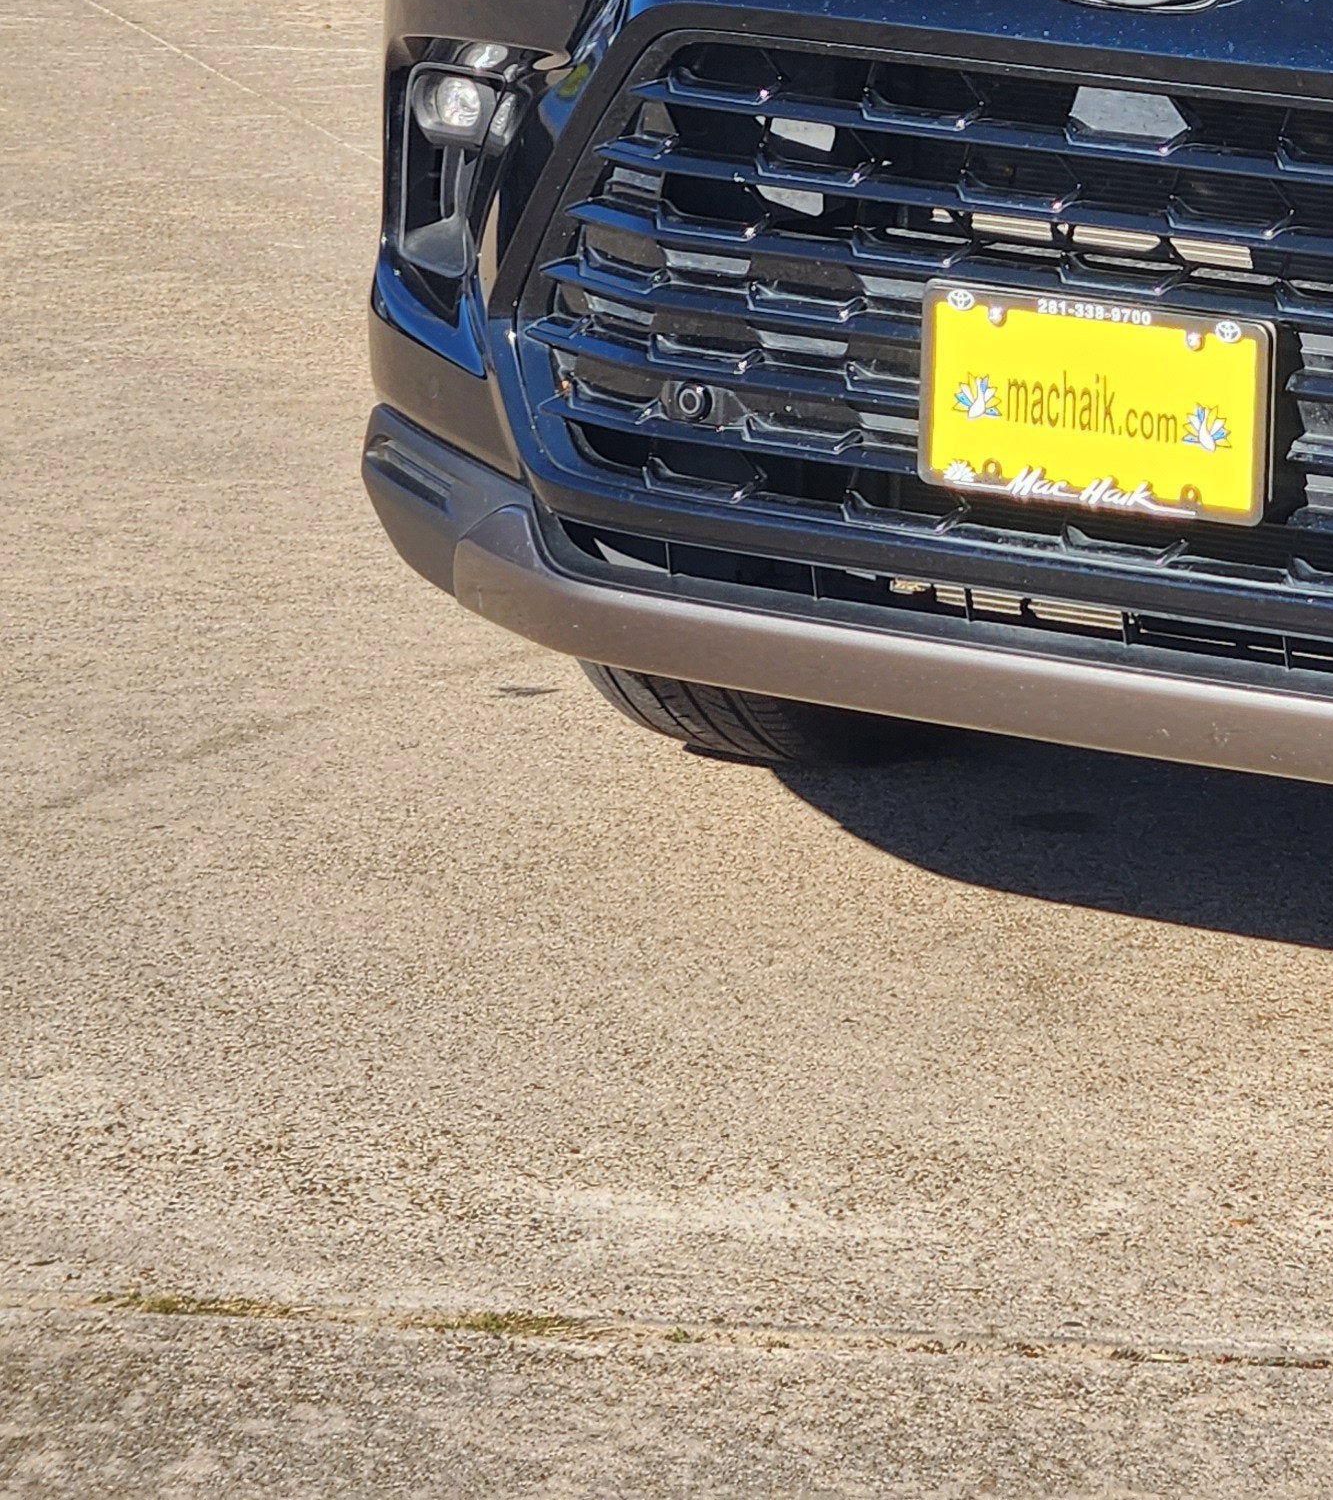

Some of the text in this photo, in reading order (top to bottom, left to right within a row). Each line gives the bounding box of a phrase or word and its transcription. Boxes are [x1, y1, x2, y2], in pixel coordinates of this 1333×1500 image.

[1036, 298, 1152, 326] 281-338-9700
[1005, 370, 1178, 444] machaik.com
[1000, 464, 1170, 510] Mac Haik
